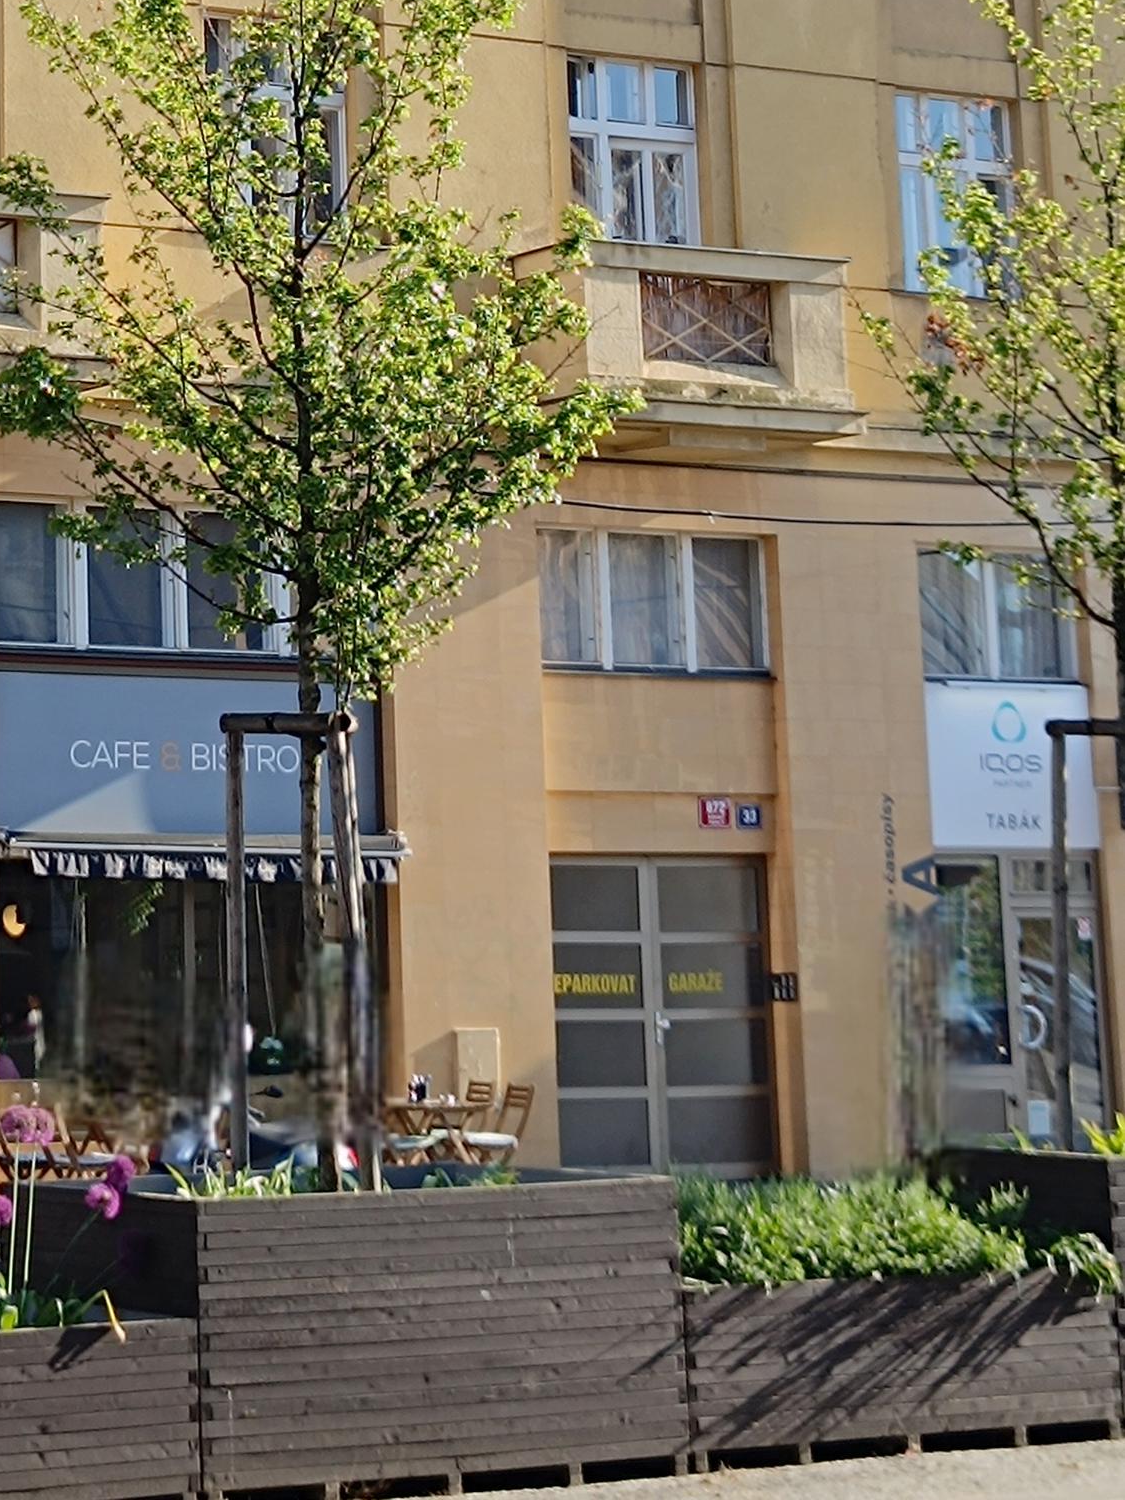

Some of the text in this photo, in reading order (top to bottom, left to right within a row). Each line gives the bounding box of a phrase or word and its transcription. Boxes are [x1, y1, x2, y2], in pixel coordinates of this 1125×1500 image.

[69, 739, 151, 770] CAFE
[159, 740, 182, 773] &
[979, 752, 1043, 775] IQOS
[986, 809, 1043, 831] TABÁK
[554, 971, 636, 995] EPARKOVAT
